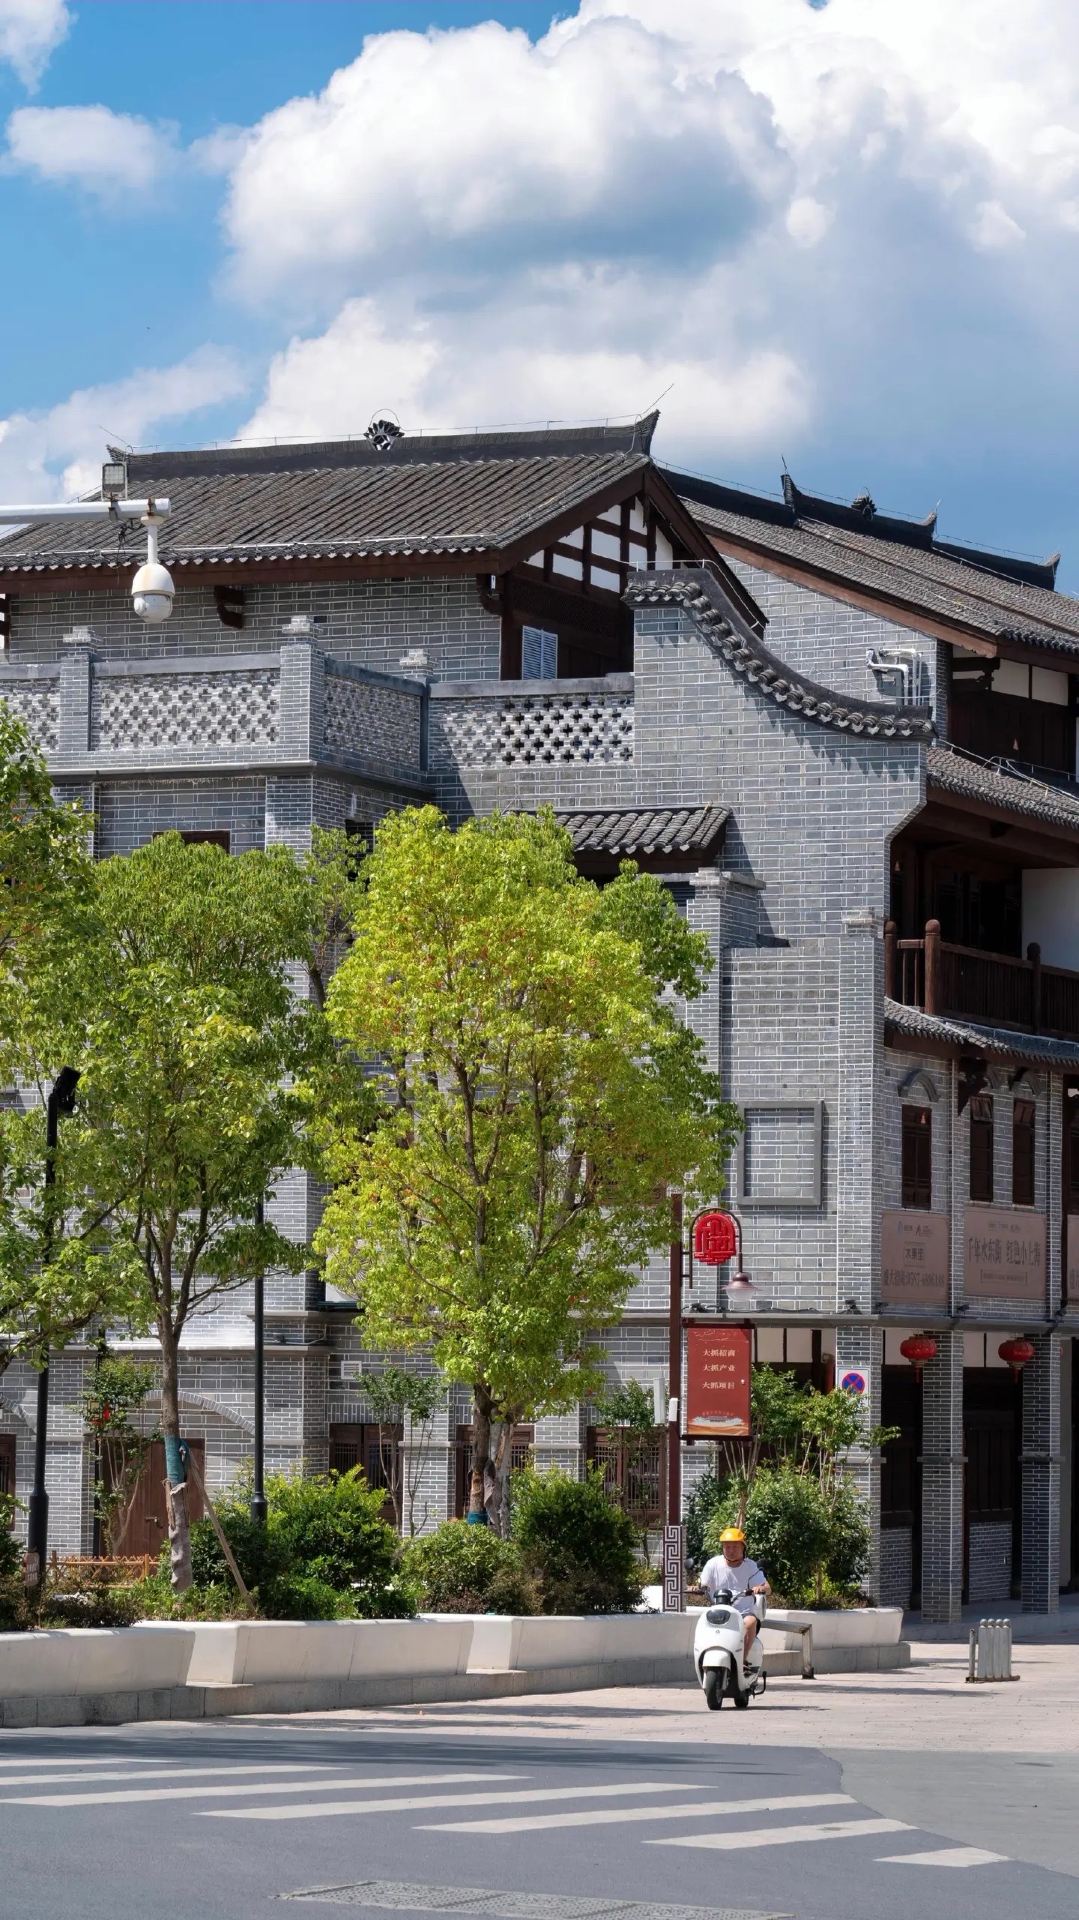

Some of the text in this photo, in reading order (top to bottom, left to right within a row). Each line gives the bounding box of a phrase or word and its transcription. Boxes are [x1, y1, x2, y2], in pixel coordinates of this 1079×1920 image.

[703, 1348, 736, 1357] 大抓招商
[703, 1363, 735, 1372] 大抓产业
[702, 1381, 735, 1390] 大抓项目
